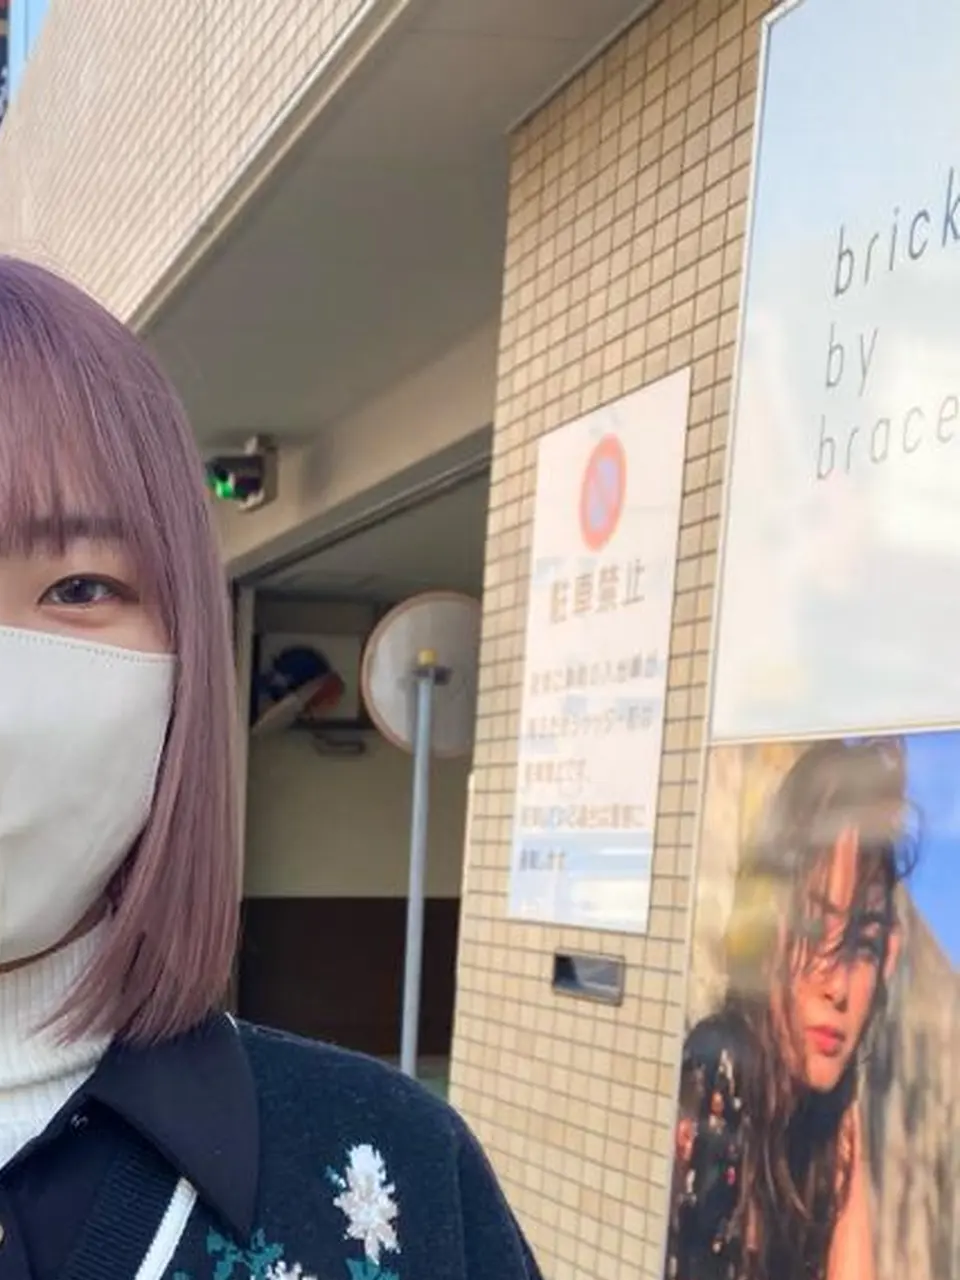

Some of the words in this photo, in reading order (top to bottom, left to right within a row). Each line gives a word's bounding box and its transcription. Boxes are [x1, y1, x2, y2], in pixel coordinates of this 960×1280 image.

[835, 166, 960, 297] brick
[826, 323, 878, 398] by
[549, 558, 645, 624] 駐車禁止
